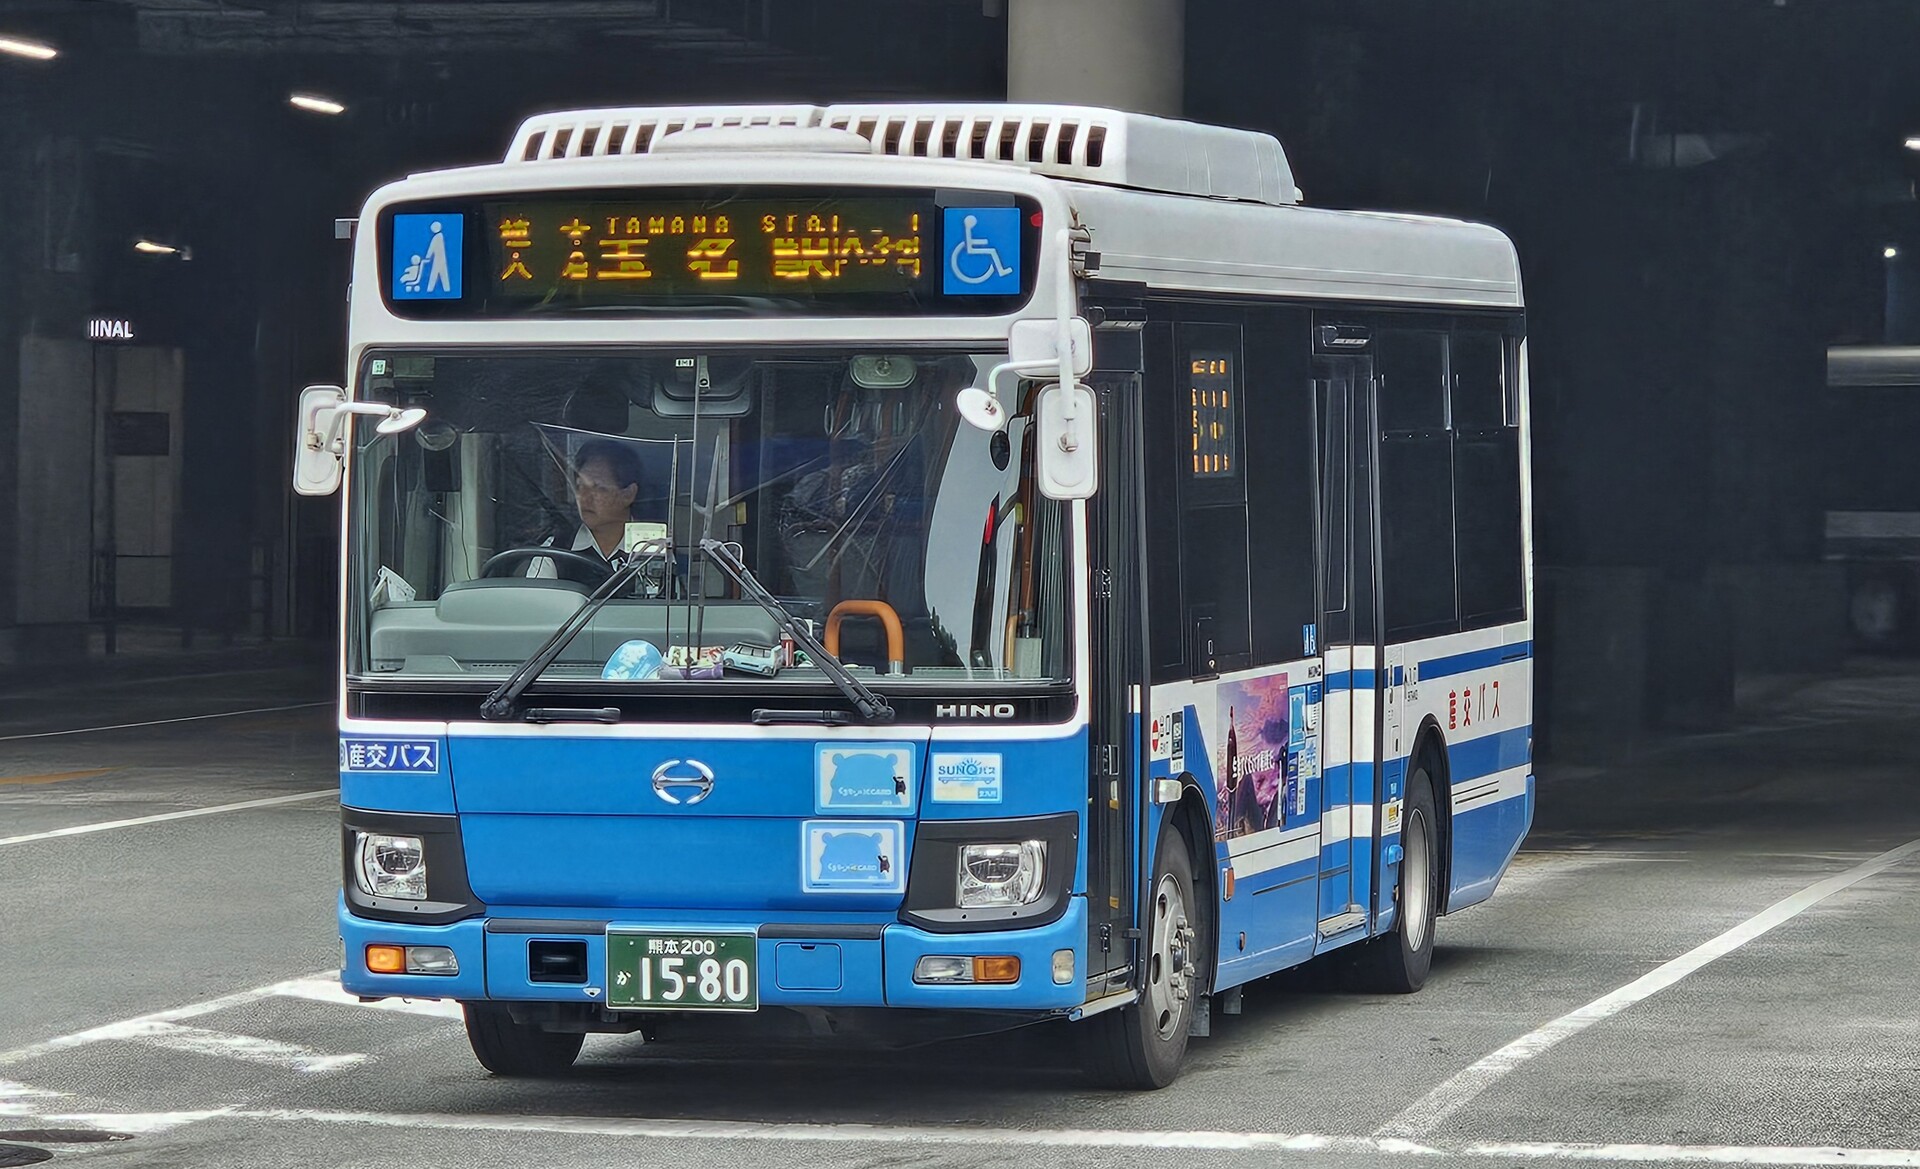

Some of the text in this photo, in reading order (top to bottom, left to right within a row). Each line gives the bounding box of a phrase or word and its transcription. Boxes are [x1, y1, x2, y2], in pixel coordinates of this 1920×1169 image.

[606, 216, 729, 234] TAMANA
[936, 704, 1015, 718] HINO
[349, 743, 434, 768] 産交バス
[617, 957, 749, 1002] か 15-80
